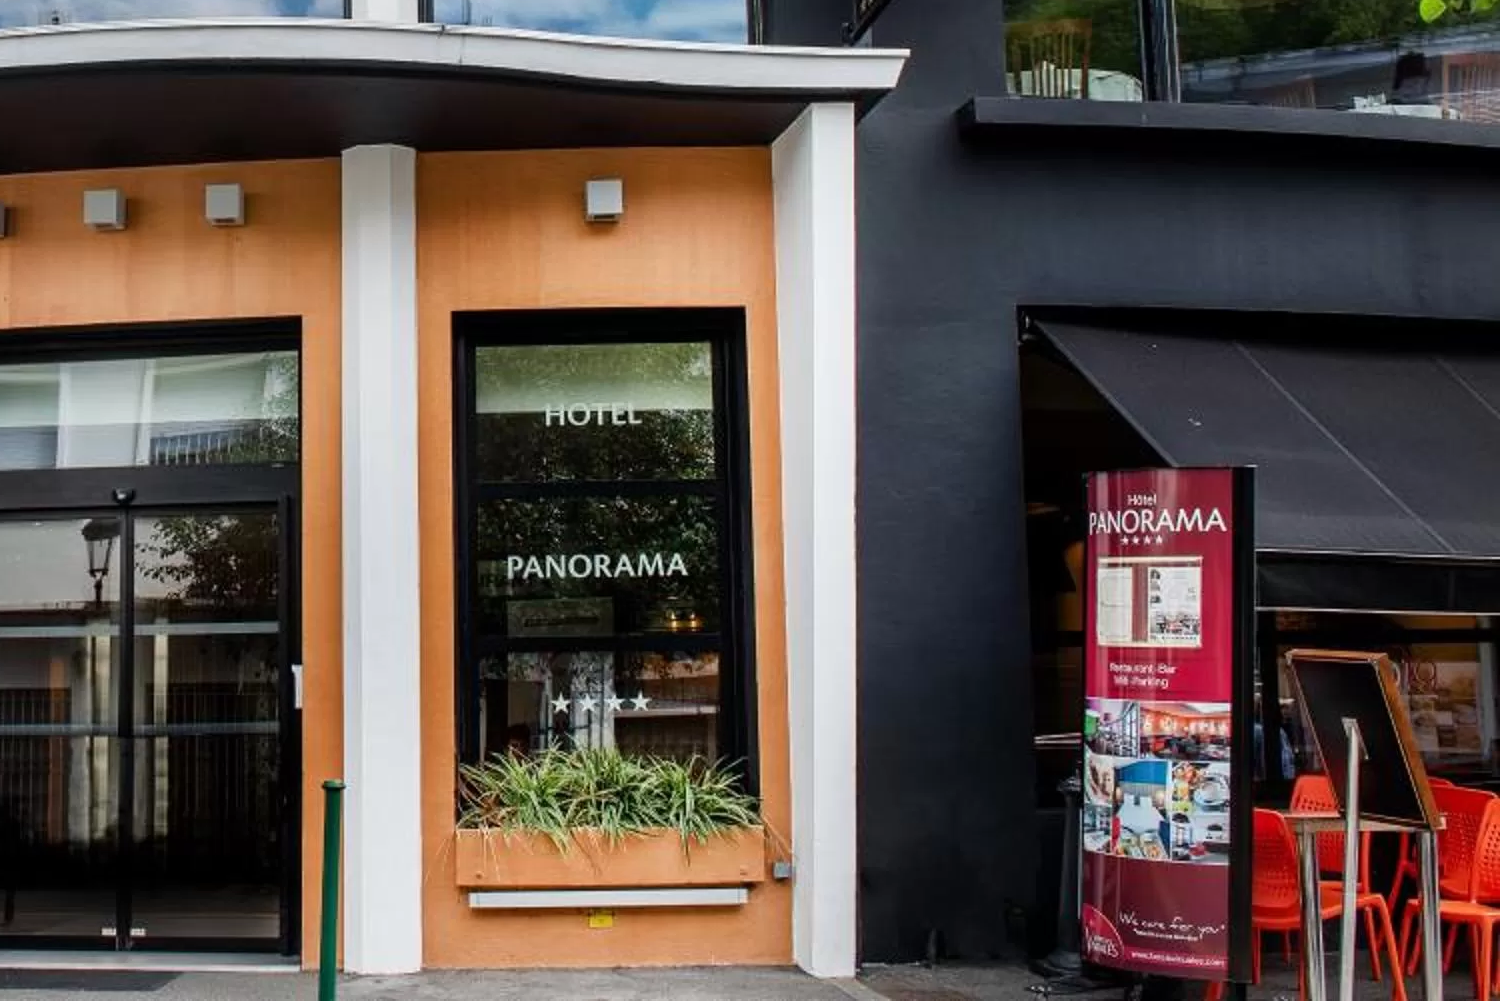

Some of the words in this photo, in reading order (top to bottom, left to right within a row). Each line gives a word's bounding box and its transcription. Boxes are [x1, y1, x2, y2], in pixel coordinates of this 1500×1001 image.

[545, 402, 642, 427] HOTEL
[1089, 507, 1228, 536] PANORAMA
[507, 552, 688, 580] PANORAMA
